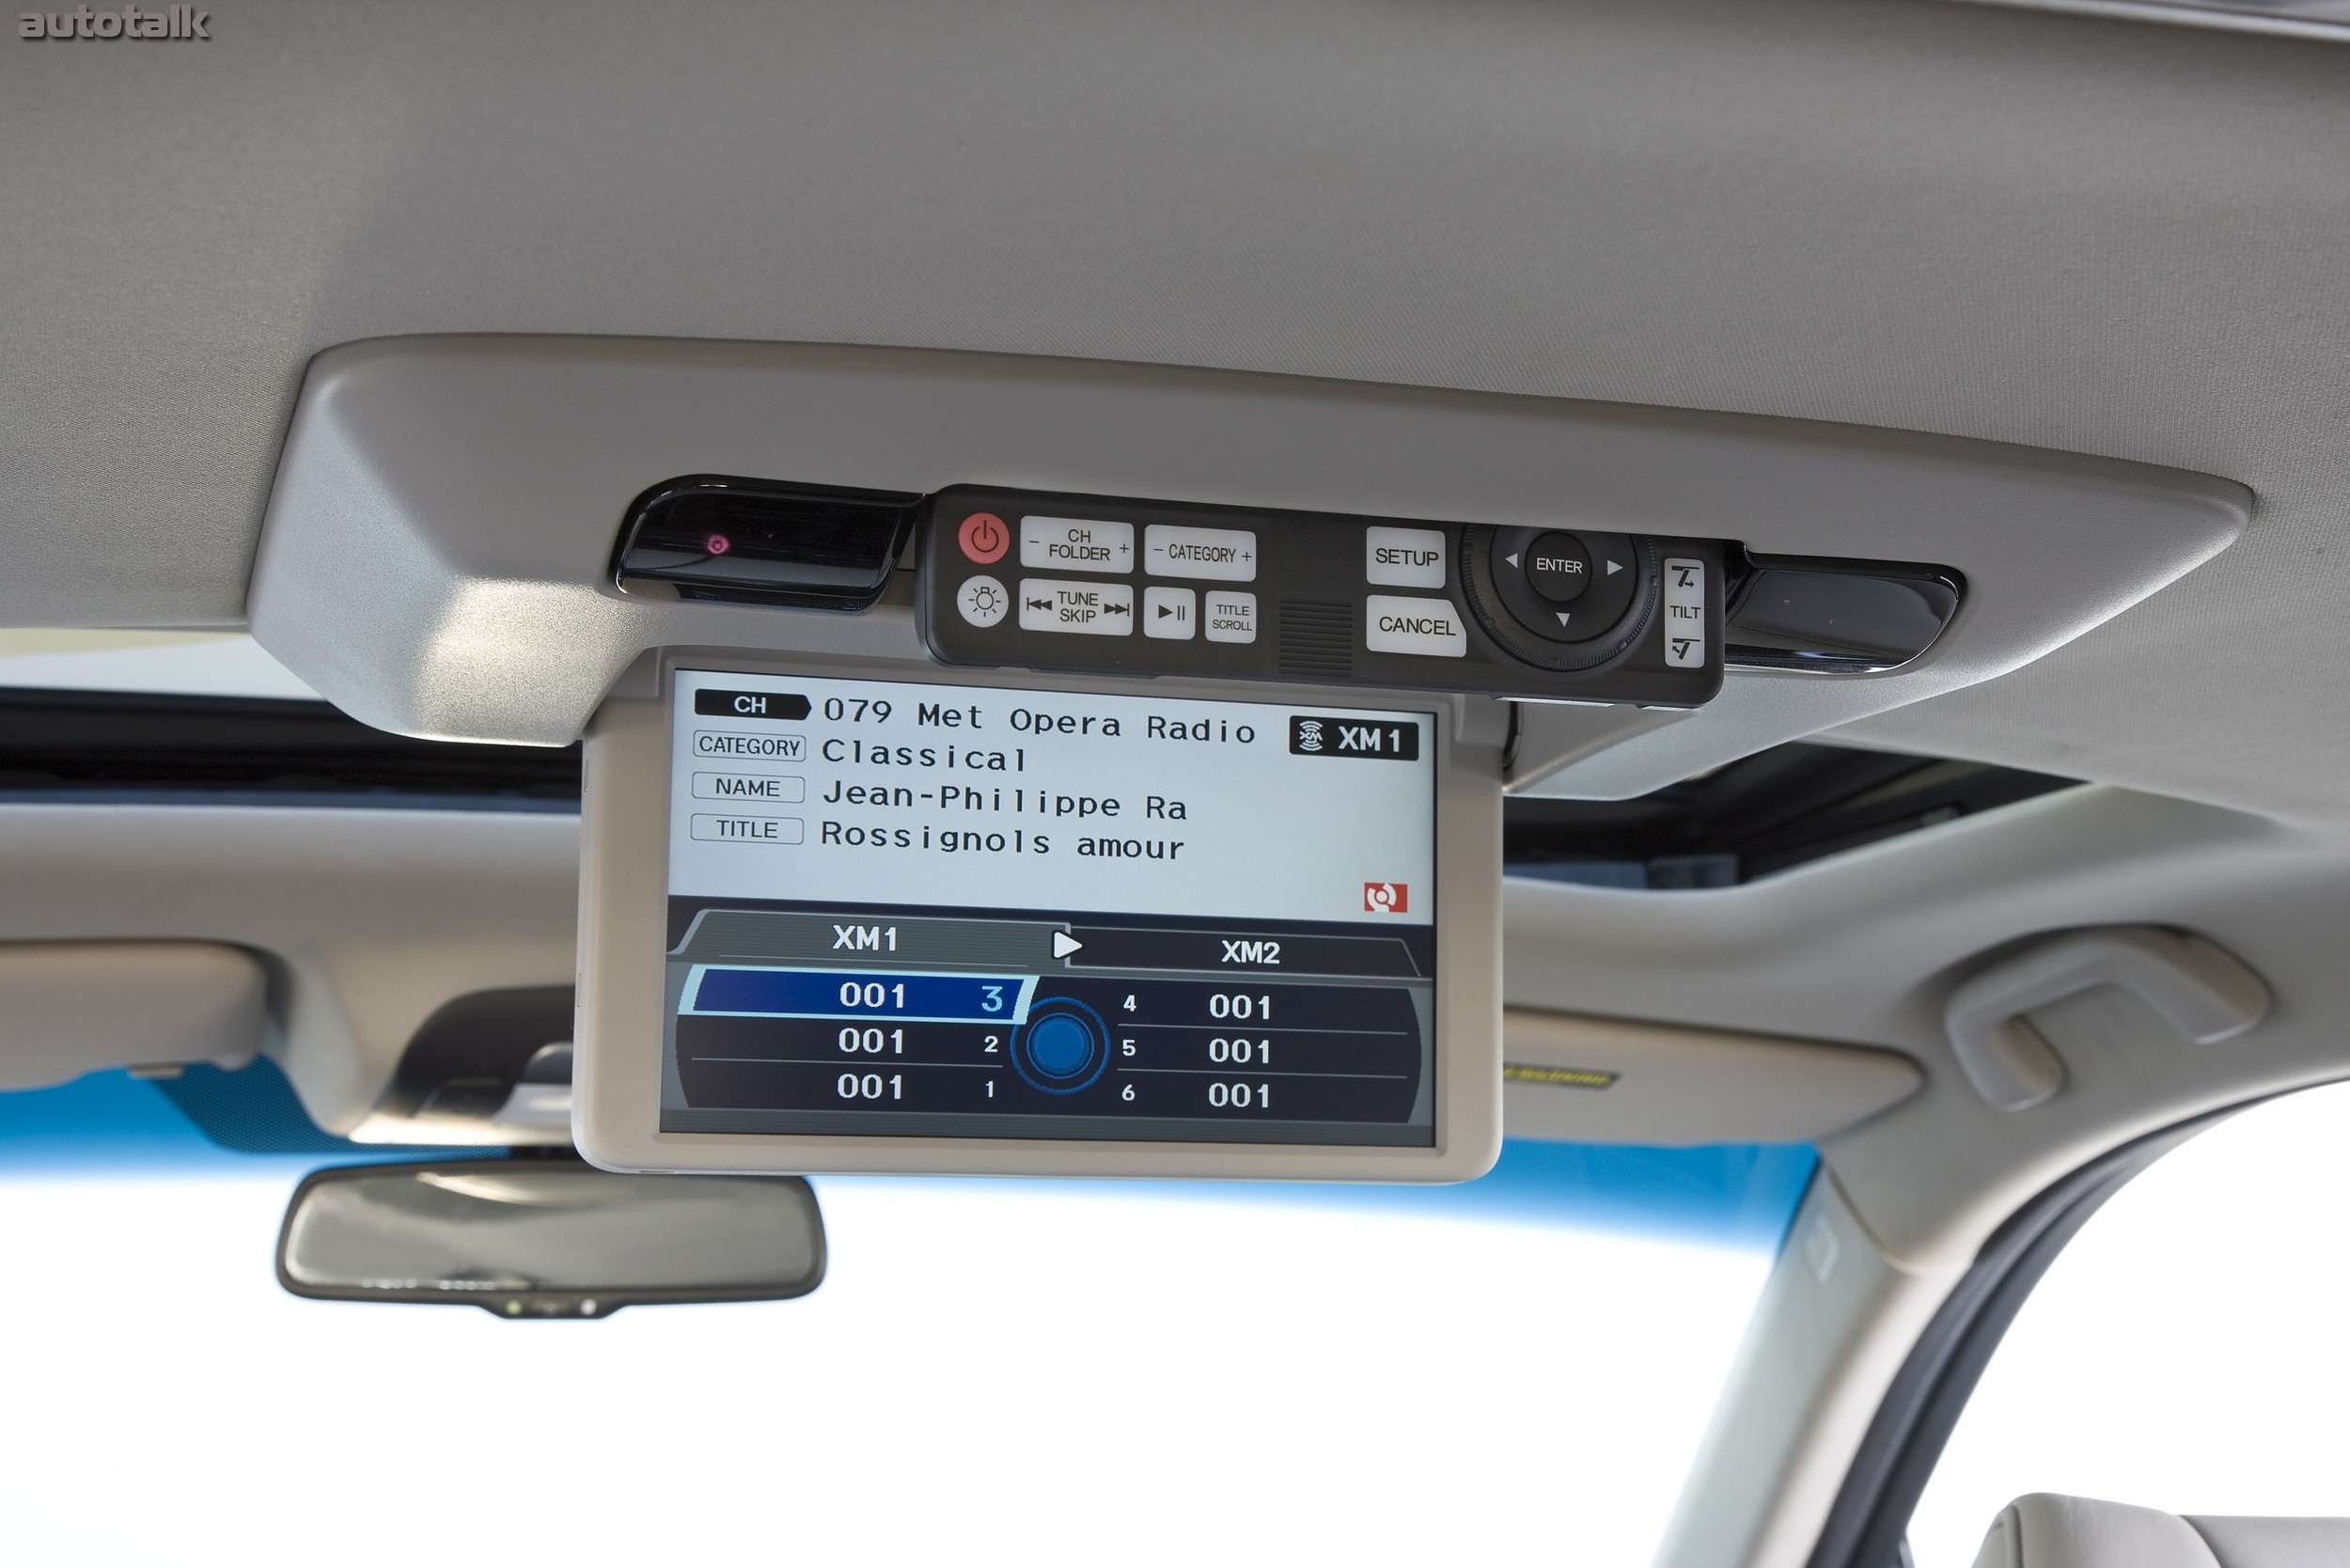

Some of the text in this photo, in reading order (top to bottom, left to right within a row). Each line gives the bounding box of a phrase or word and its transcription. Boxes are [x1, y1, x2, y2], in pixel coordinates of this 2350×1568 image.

[1068, 529, 1091, 543] CH
[1049, 544, 1110, 561] FOLDER
[1168, 543, 1236, 563] CATEGORY
[1375, 547, 1439, 567] SETUP
[1536, 557, 1583, 574] ENTER
[1057, 590, 1099, 606] TUNE
[1059, 609, 1096, 623] SKIP
[1215, 604, 1250, 617] TITLE
[1669, 605, 1701, 619] TILT
[1212, 619, 1253, 632] SCROLL
[1379, 617, 1456, 636] CANCEL
[733, 696, 767, 714] CH
[823, 698, 1256, 744] 079 Met Opera Radio
[698, 736, 800, 757] CATEGORY
[822, 738, 1025, 772] Classical
[715, 777, 780, 796] NAME
[823, 780, 1187, 820] Jean-Philippe Ra
[716, 819, 778, 839] TITLE
[822, 821, 1184, 860] Rossignols amour
[833, 924, 897, 951] XM1
[1221, 939, 1280, 964] XM2
[839, 981, 1003, 1012] 001 3
[1123, 994, 1270, 1020] 4 001
[838, 1027, 998, 1054] 001 2
[1122, 1038, 1270, 1064] 5 001
[837, 1074, 994, 1100] 001 1
[1121, 1082, 1269, 1108] 6 001
